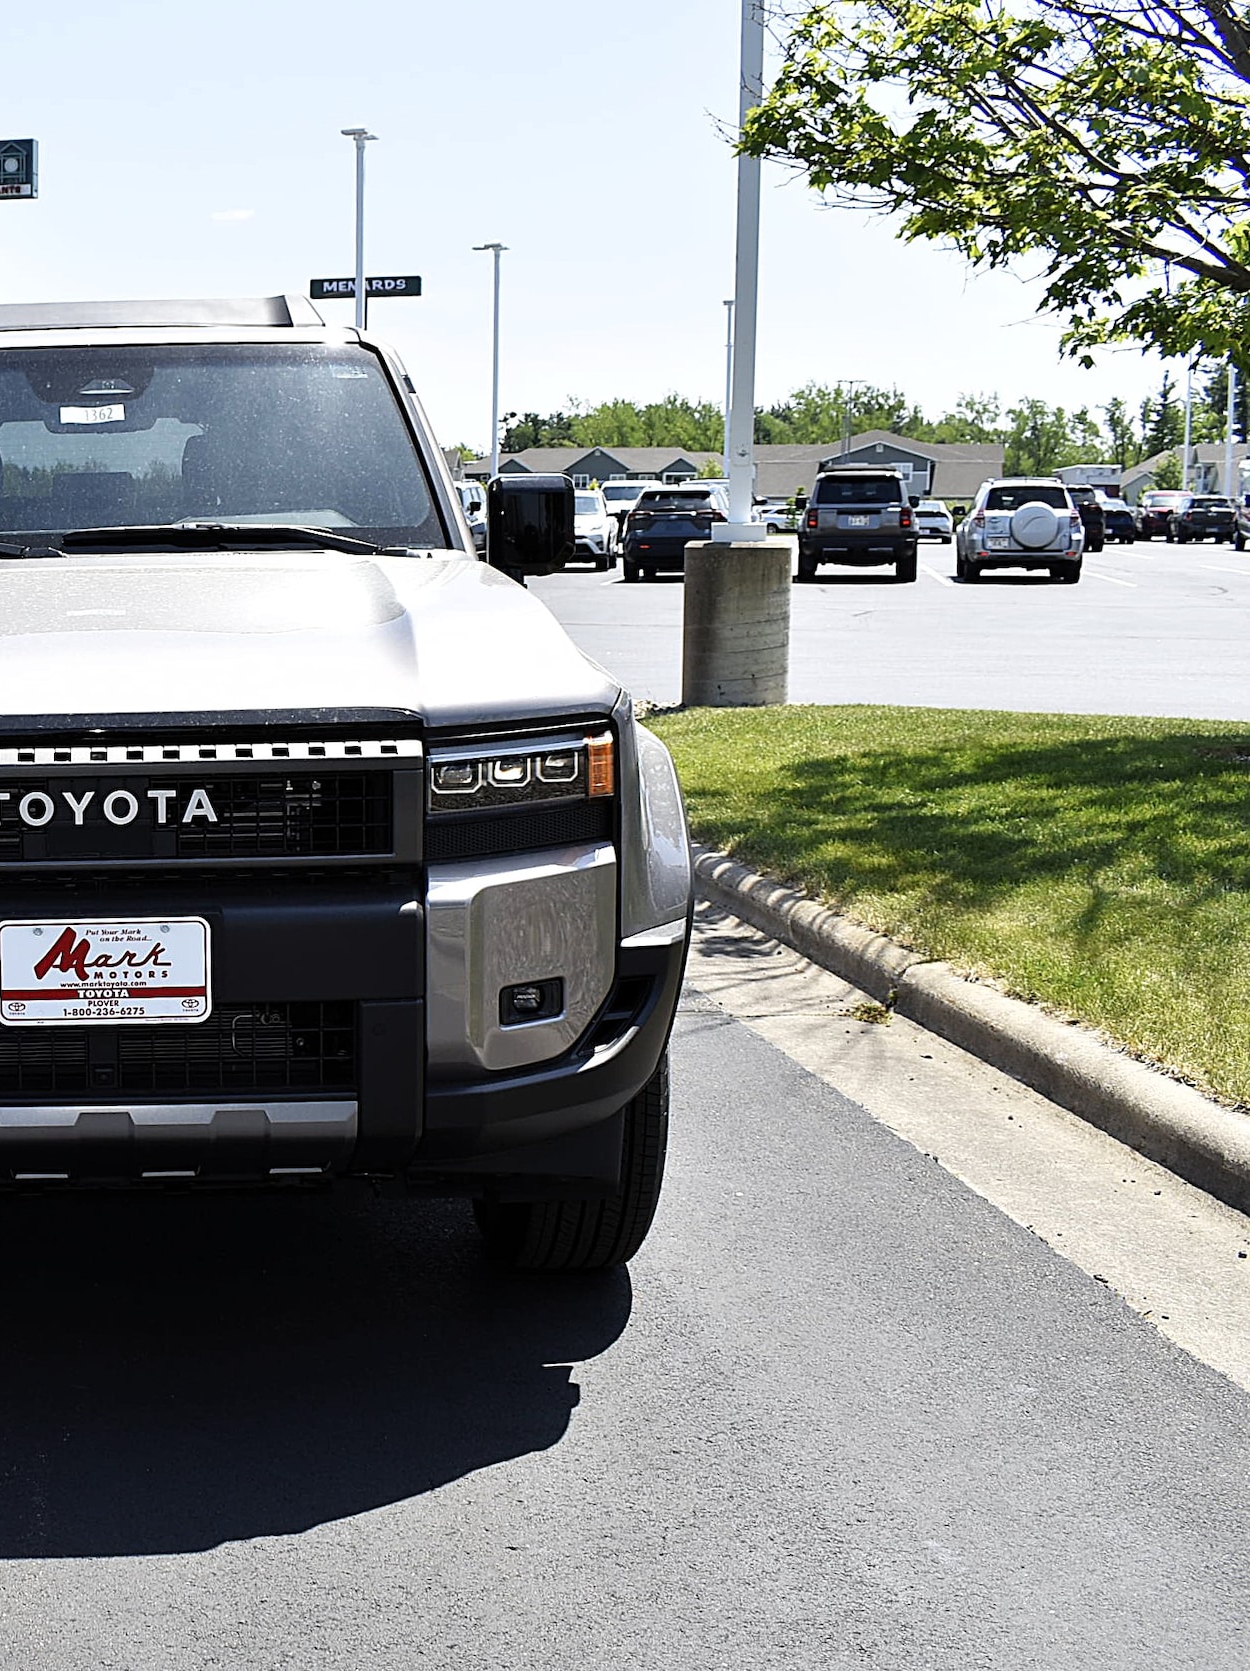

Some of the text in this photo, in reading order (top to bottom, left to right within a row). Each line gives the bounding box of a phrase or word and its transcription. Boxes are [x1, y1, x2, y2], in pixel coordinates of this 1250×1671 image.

[34, 927, 171, 981] Mark
[94, 970, 168, 979] MOTORS
[60, 980, 147, 989] www.marktoyota.com
[77, 989, 130, 999] TOYOTA
[63, 1007, 145, 1017] 1-800-236-6275
